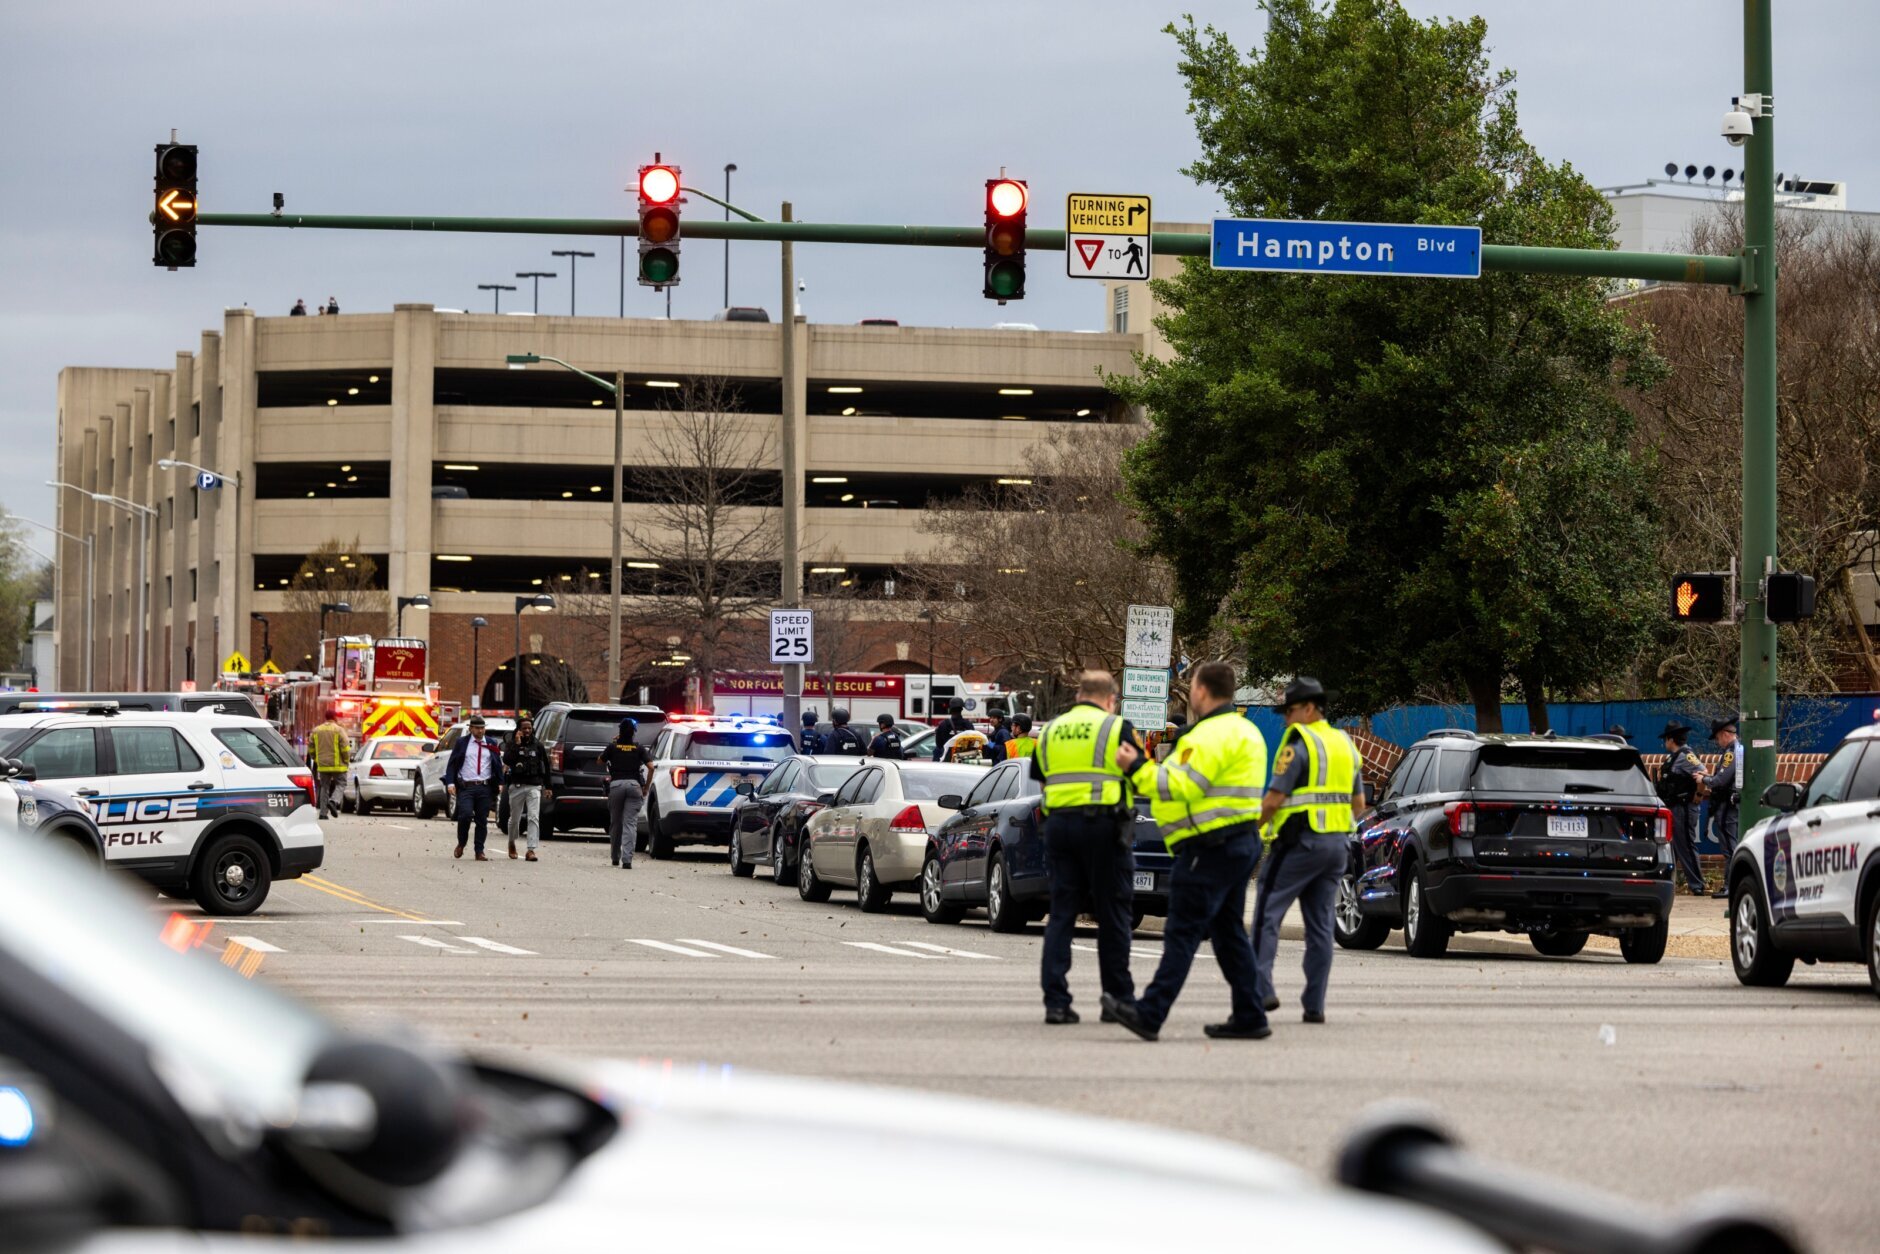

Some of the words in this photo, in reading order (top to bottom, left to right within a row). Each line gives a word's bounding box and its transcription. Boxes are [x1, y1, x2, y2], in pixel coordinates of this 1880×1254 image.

[1072, 199, 1125, 212] TURNING
[1072, 214, 1125, 227] VEHICLES
[1108, 248, 1122, 260] TO
[1237, 231, 1394, 266] Hampton
[1417, 238, 1456, 253] Blvd
[203, 473, 214, 488] P
[774, 616, 810, 625] SPEED
[777, 627, 806, 636] LIMIT
[774, 637, 809, 657] 25
[387, 649, 415, 660] LADDER
[395, 656, 406, 670] 7
[729, 679, 784, 690] NORFOLK
[1053, 722, 1093, 742] POLICE
[267, 798, 289, 807] 911
[1551, 821, 1586, 832] TFL-1133
[103, 830, 164, 848] FOLK
[1795, 842, 1860, 880] NORFOLK
[1799, 884, 1824, 900] POLICE
